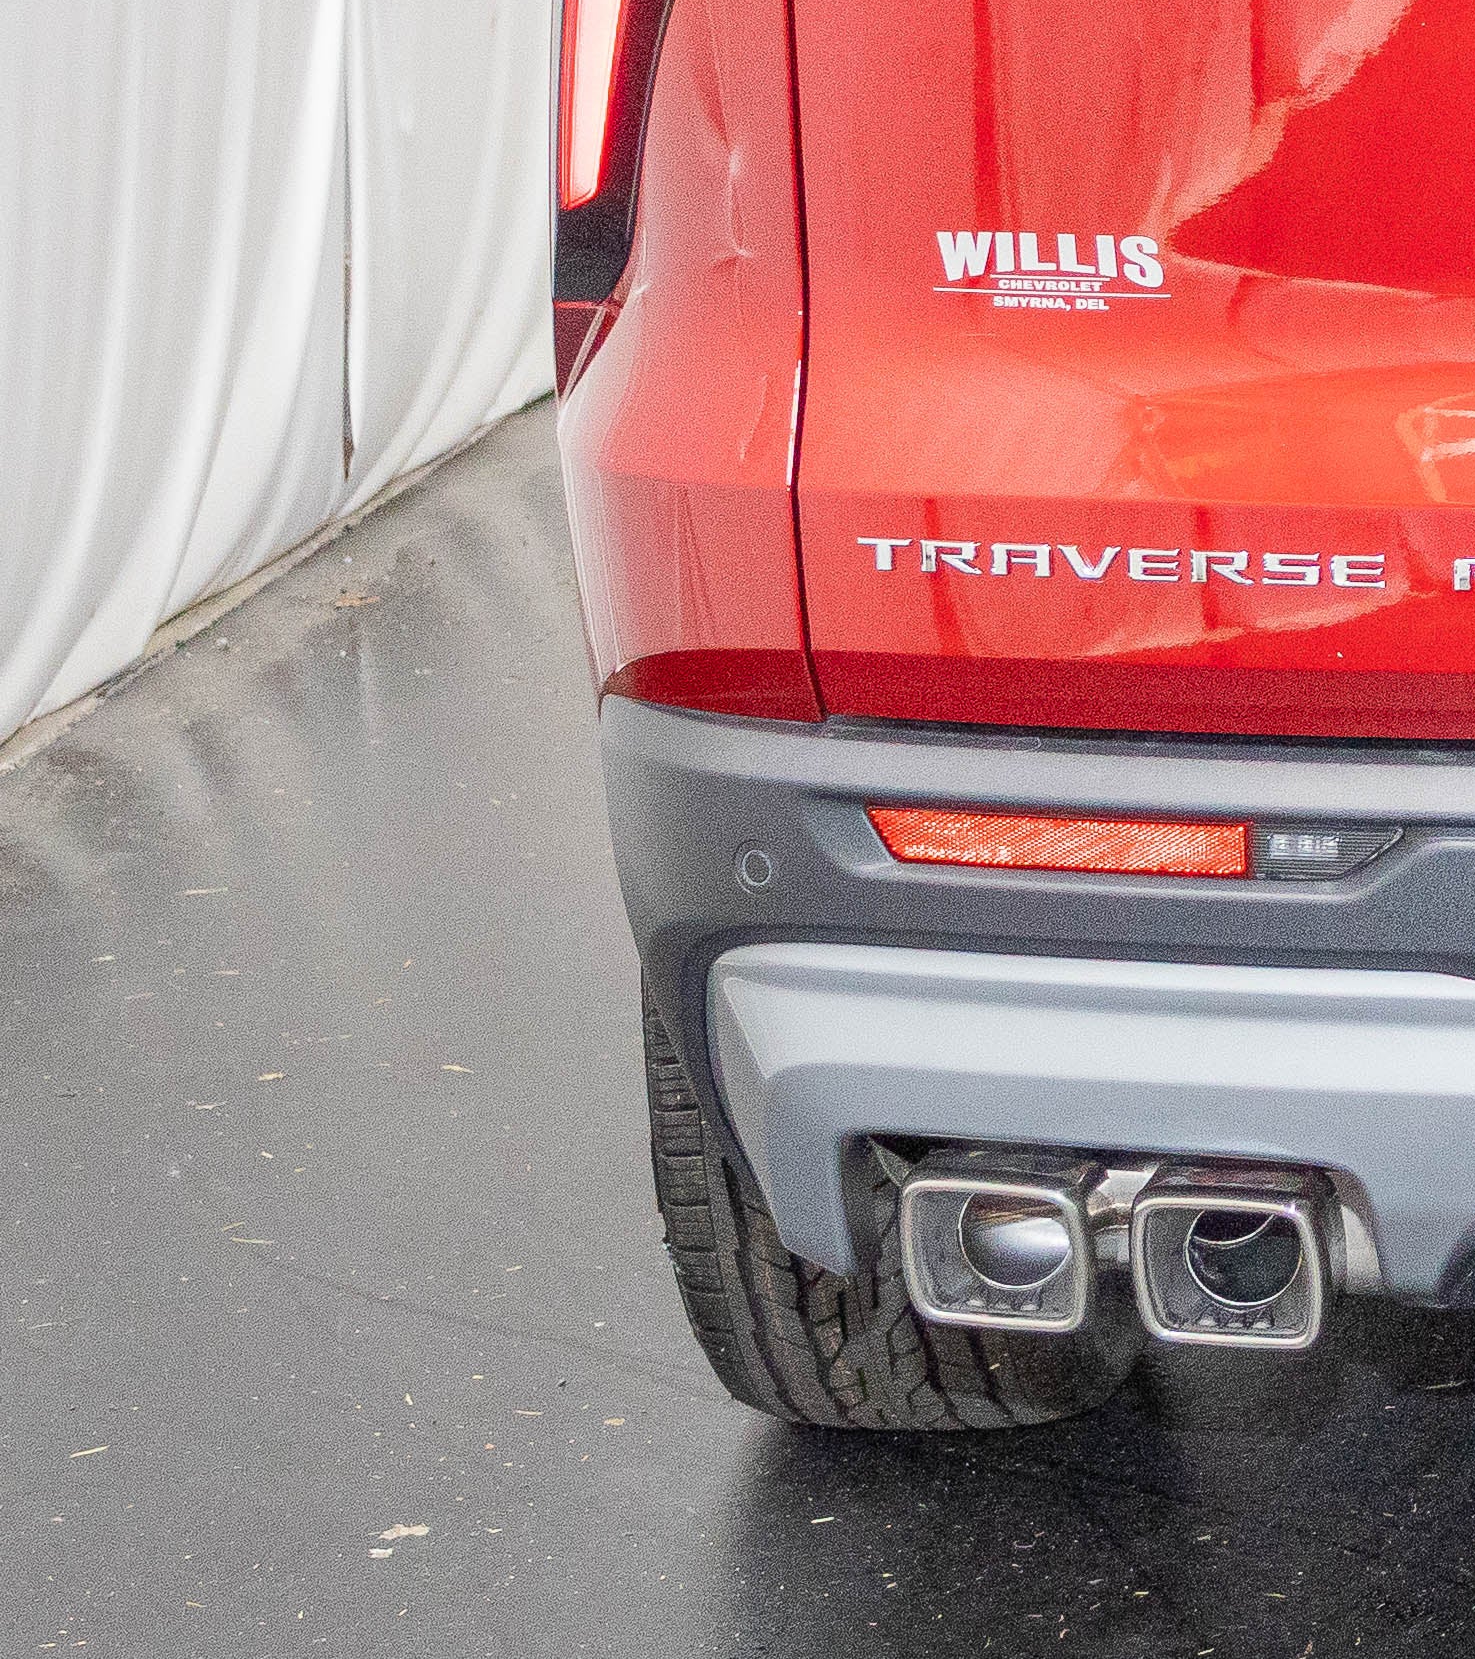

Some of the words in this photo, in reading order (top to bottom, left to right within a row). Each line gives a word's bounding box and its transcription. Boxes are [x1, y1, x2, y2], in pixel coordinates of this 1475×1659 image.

[936, 230, 1165, 288] WILLIS
[998, 278, 1103, 292] CHEVROLET
[993, 295, 1072, 312] SMYRNA,
[856, 536, 1387, 590] TRAVERSE
